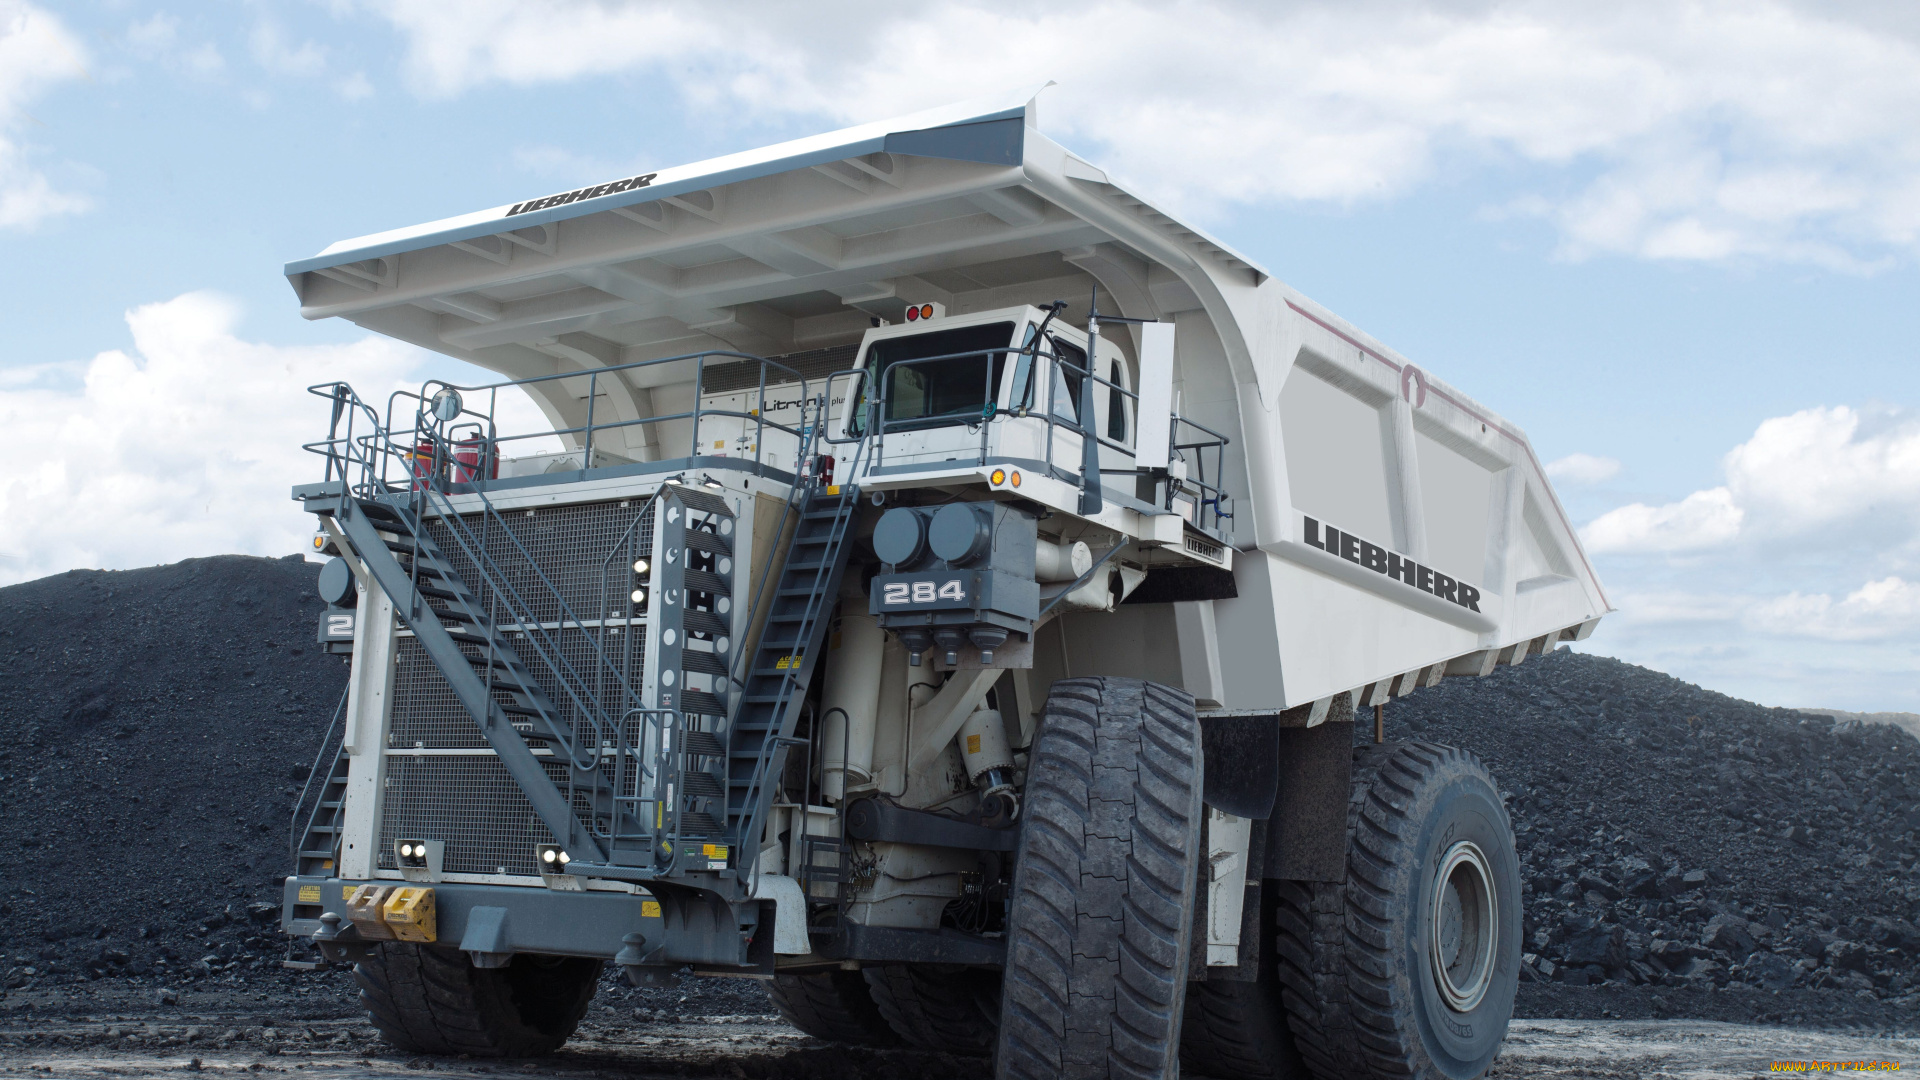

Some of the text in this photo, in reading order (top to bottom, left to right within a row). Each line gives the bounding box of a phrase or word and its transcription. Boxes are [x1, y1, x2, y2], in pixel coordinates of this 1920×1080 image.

[505, 173, 657, 217] LIEBHERR
[763, 397, 828, 412] Litron
[1187, 538, 1222, 561] LIEBHER
[1304, 515, 1481, 613] LIEBHERR
[884, 580, 965, 605] 284
[328, 615, 353, 636] 2
